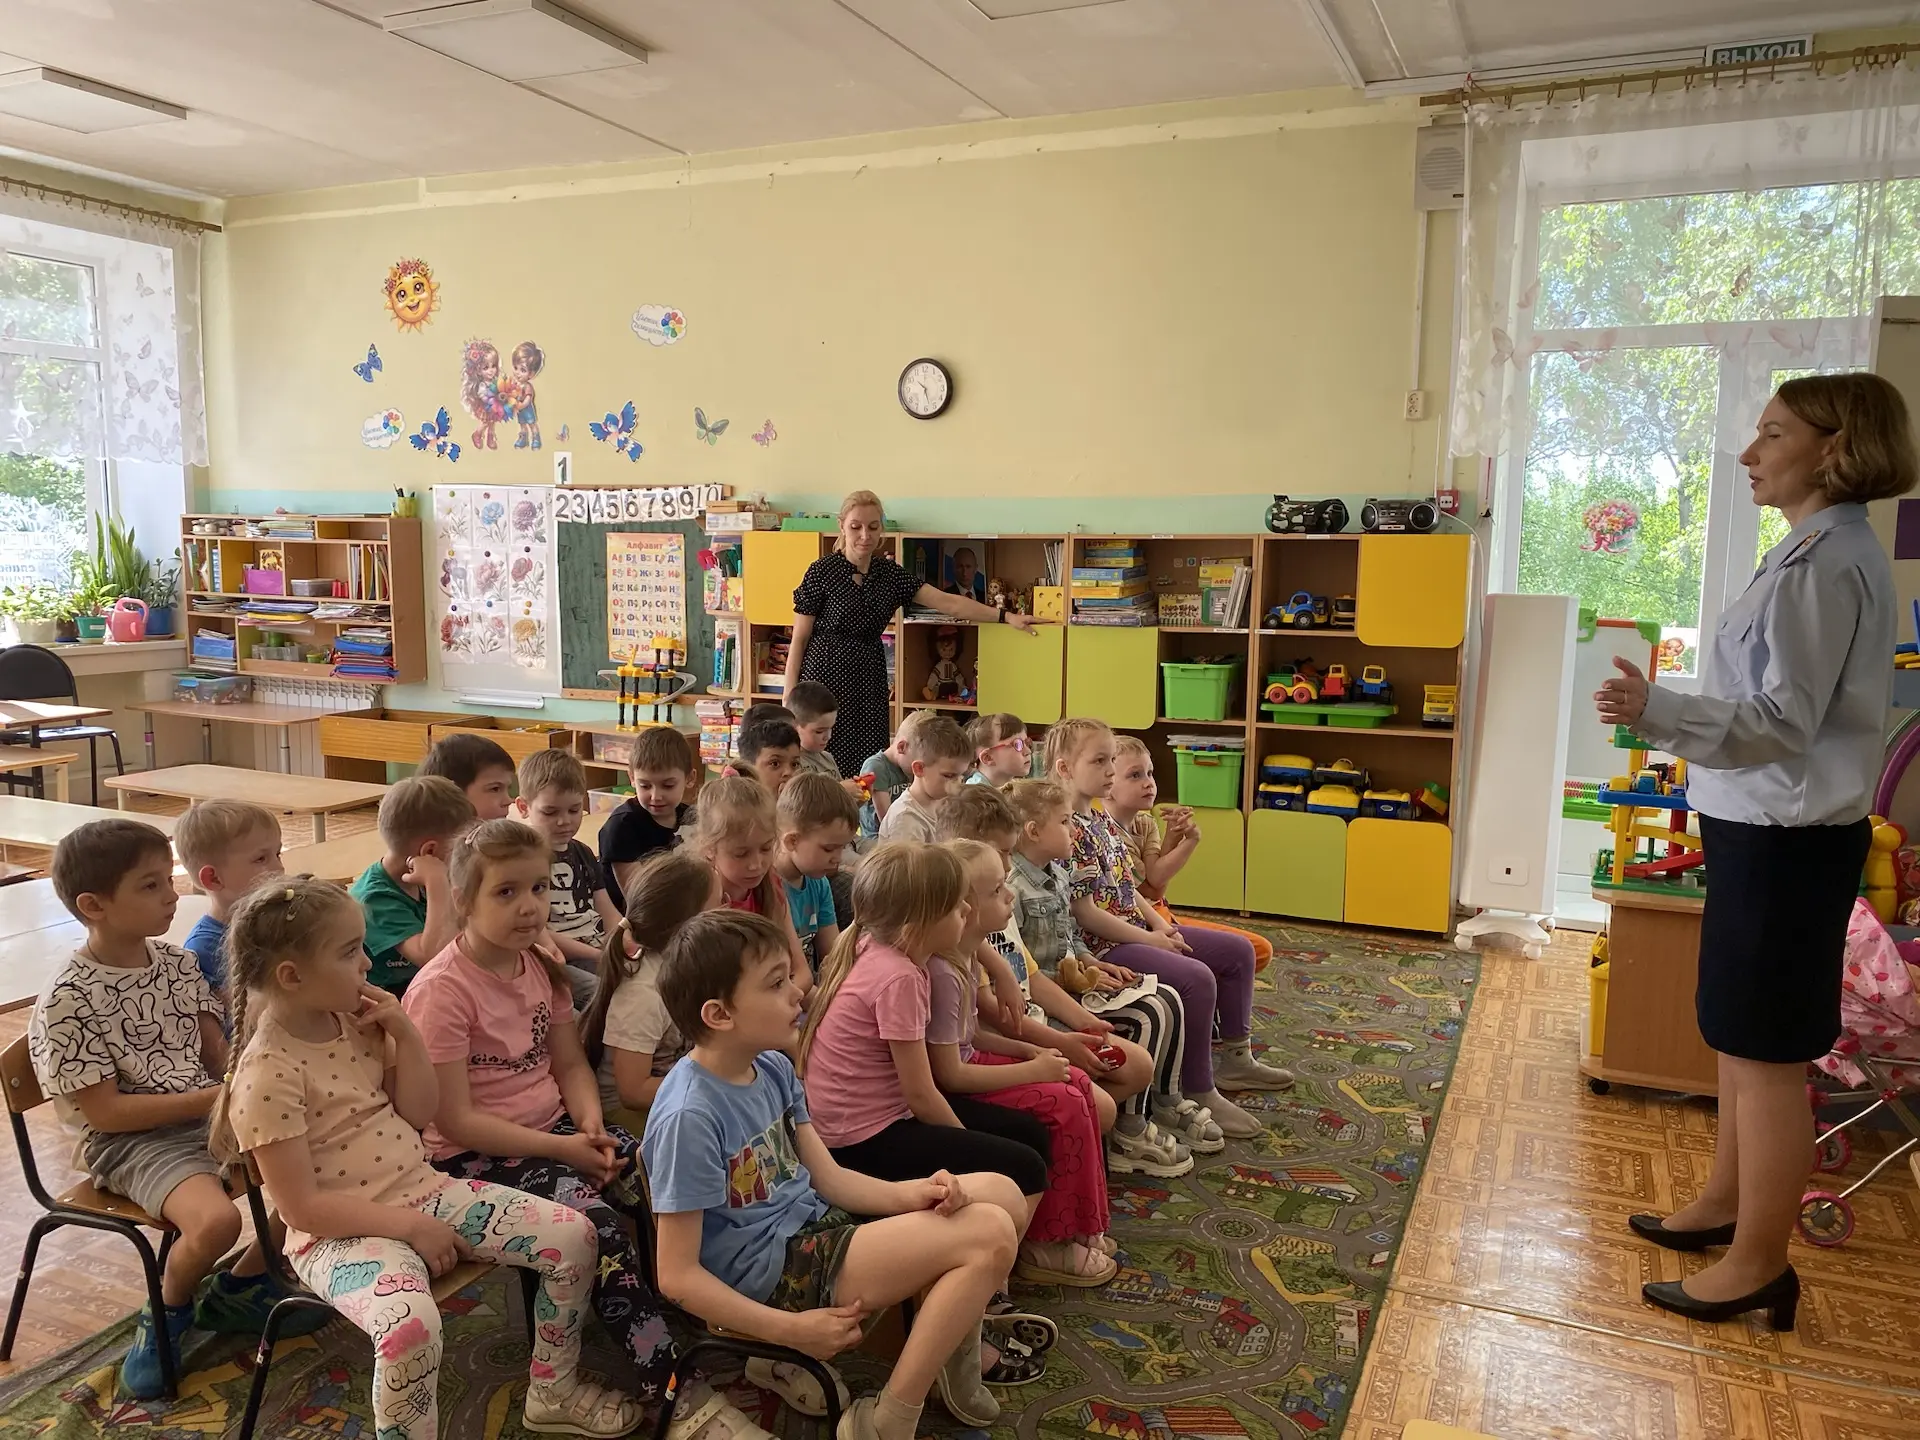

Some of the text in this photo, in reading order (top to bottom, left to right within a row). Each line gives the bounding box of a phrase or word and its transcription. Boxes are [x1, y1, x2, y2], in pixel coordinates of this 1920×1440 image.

[1716, 42, 1800, 65] ВЫХОД
[558, 456, 567, 484] 1
[555, 494, 570, 518] 2
[572, 493, 586, 518] 3
[591, 492, 604, 518] 4
[606, 494, 620, 519] 5
[624, 492, 639, 518] 6
[642, 494, 656, 518] 7
[661, 492, 676, 518] 8
[679, 490, 694, 516] 9
[626, 542, 664, 551] Алфавит
